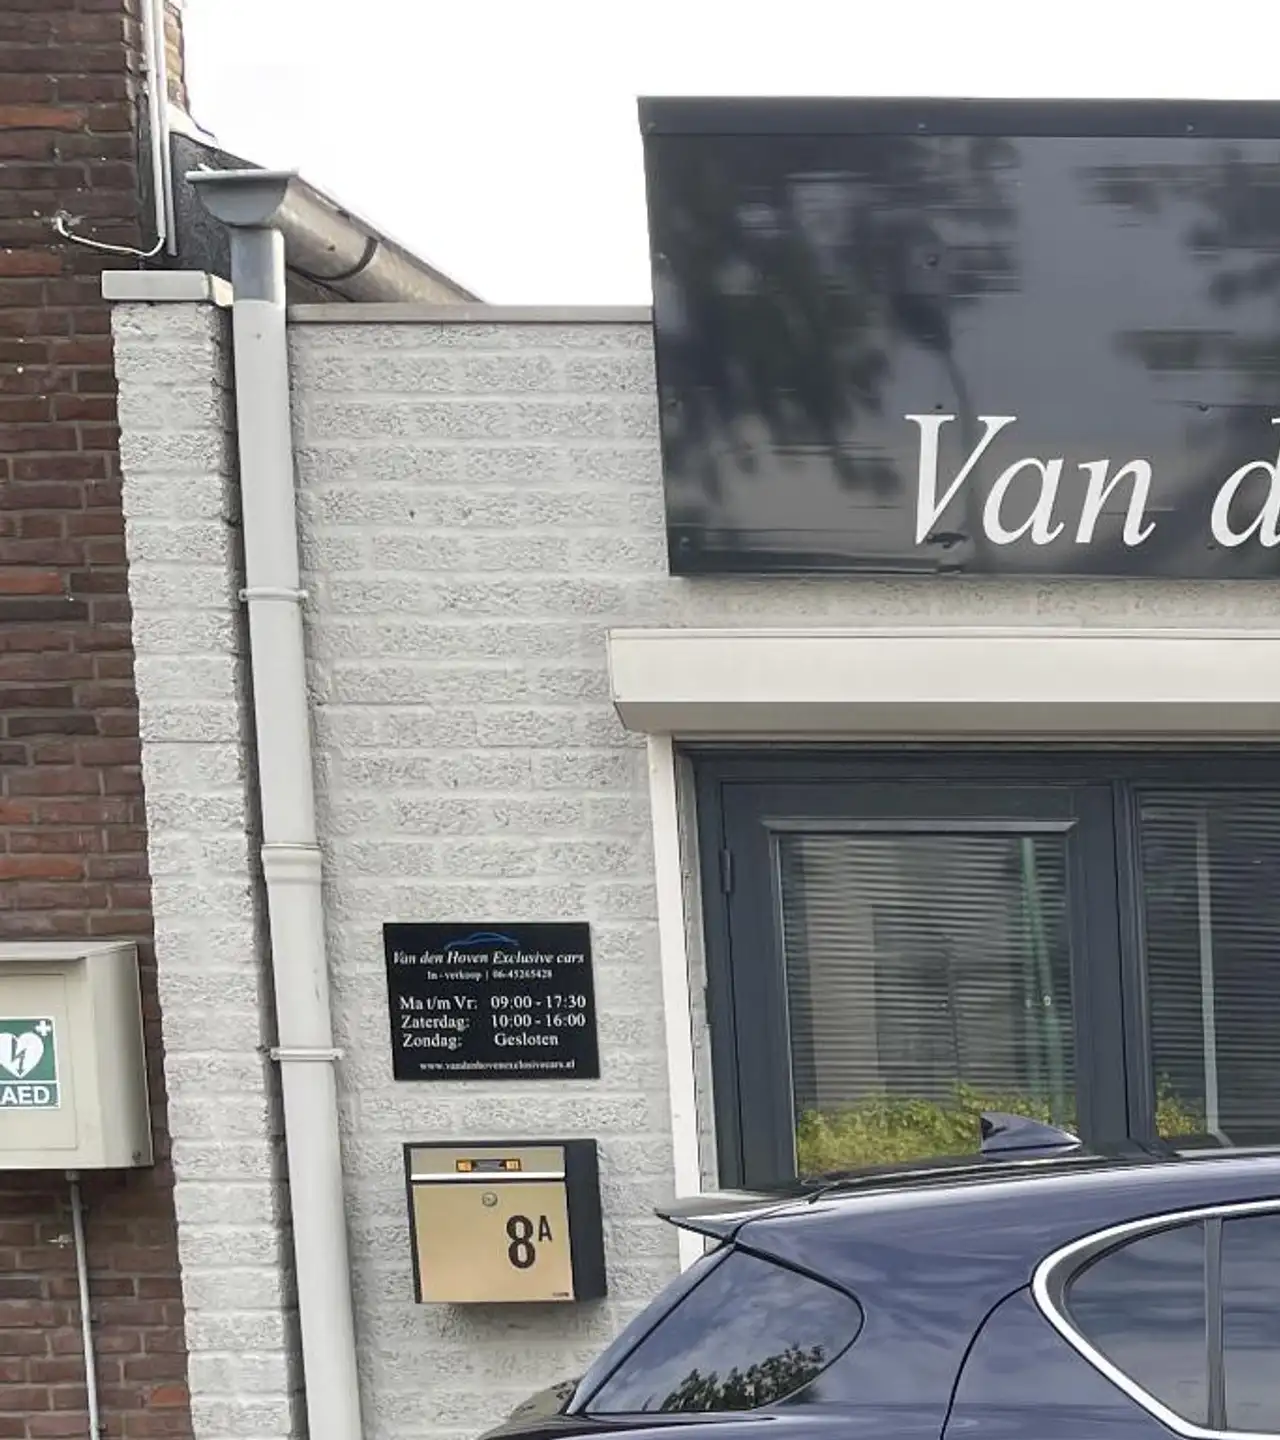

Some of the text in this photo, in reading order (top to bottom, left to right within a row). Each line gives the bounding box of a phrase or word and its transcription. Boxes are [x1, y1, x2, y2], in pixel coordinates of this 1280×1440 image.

[904, 413, 1156, 546] Van
[393, 951, 585, 966] Van den Hoven Exclusive cars
[400, 997, 424, 1010] Ma
[427, 996, 452, 1010] t/m
[490, 996, 533, 1009] 09:00
[546, 995, 587, 1009] 17:30
[401, 1014, 470, 1032] Zaterdag:
[491, 1014, 532, 1028] 10:00
[546, 1014, 587, 1027] 16:00
[402, 1032, 559, 1050] Zondag: Gesloten
[0, 1085, 50, 1105] AED
[506, 1215, 553, 1269] 8A
